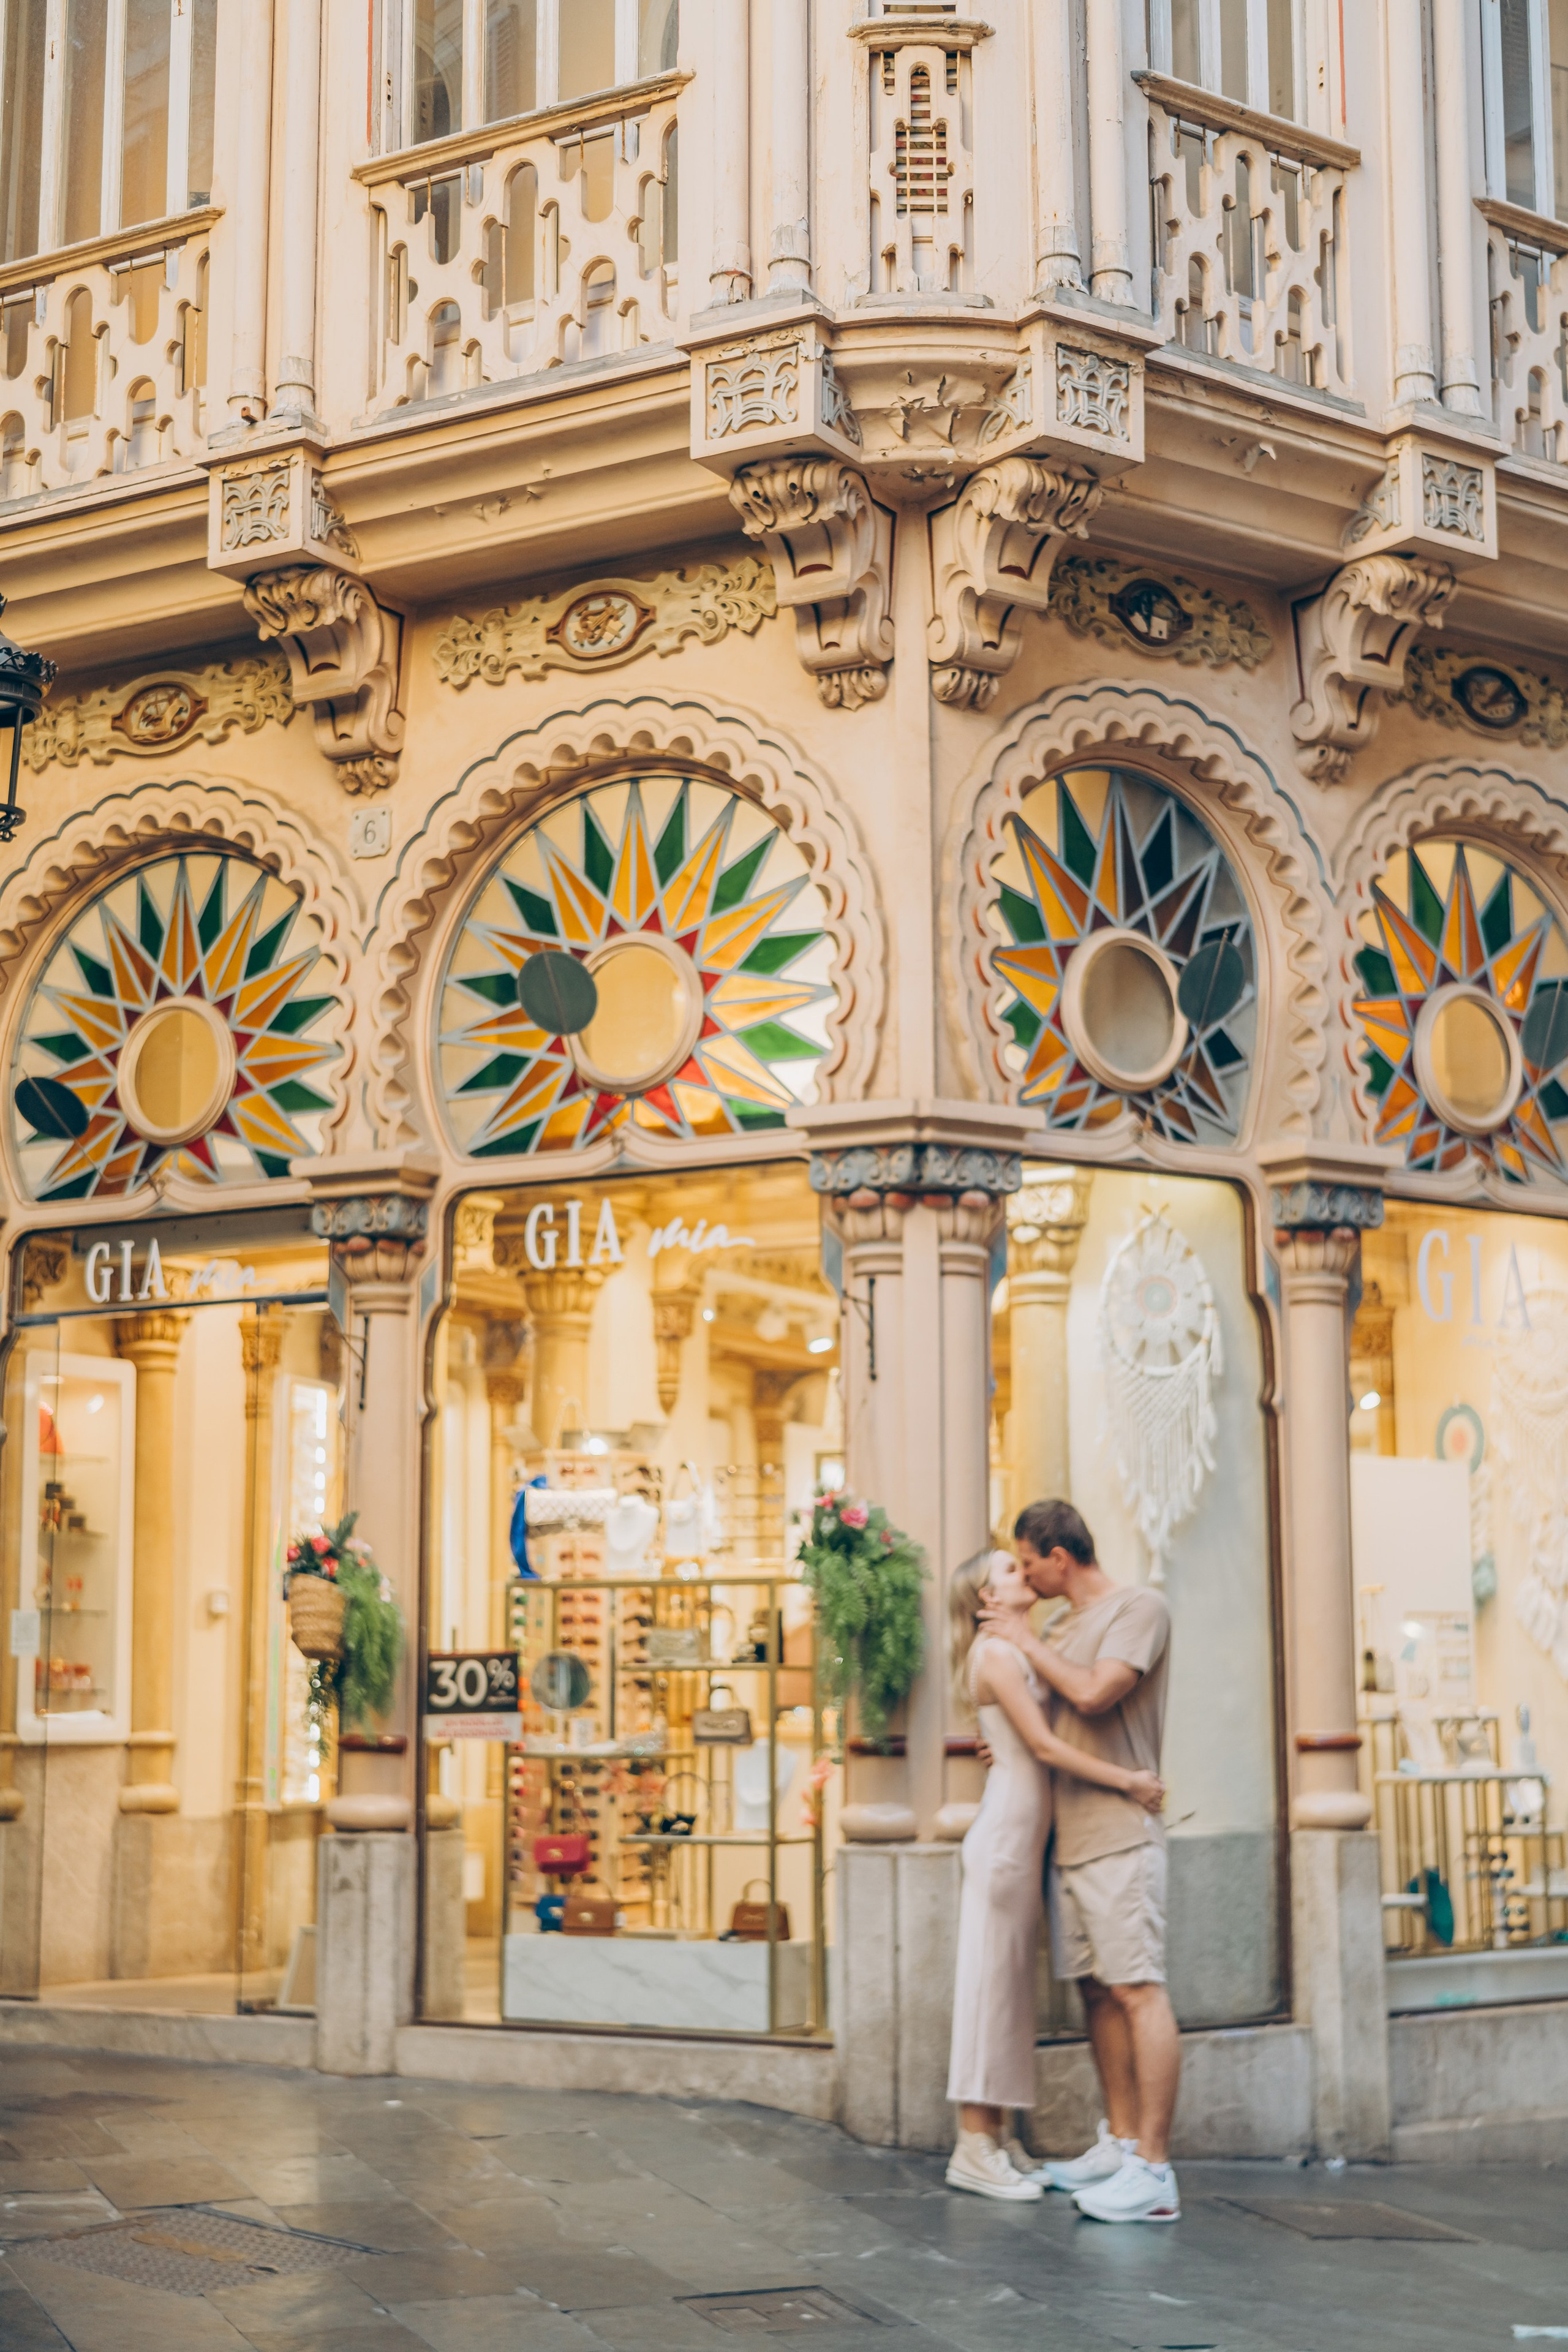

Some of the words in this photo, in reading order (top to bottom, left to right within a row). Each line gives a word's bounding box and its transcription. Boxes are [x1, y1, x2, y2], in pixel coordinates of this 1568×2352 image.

[364, 820, 375, 844] 6
[525, 1197, 625, 1270] GIA
[648, 1217, 755, 1257] mia
[85, 1238, 168, 1303] GIA
[1417, 1229, 1531, 1329] GIA
[429, 1659, 516, 1708] 30%
